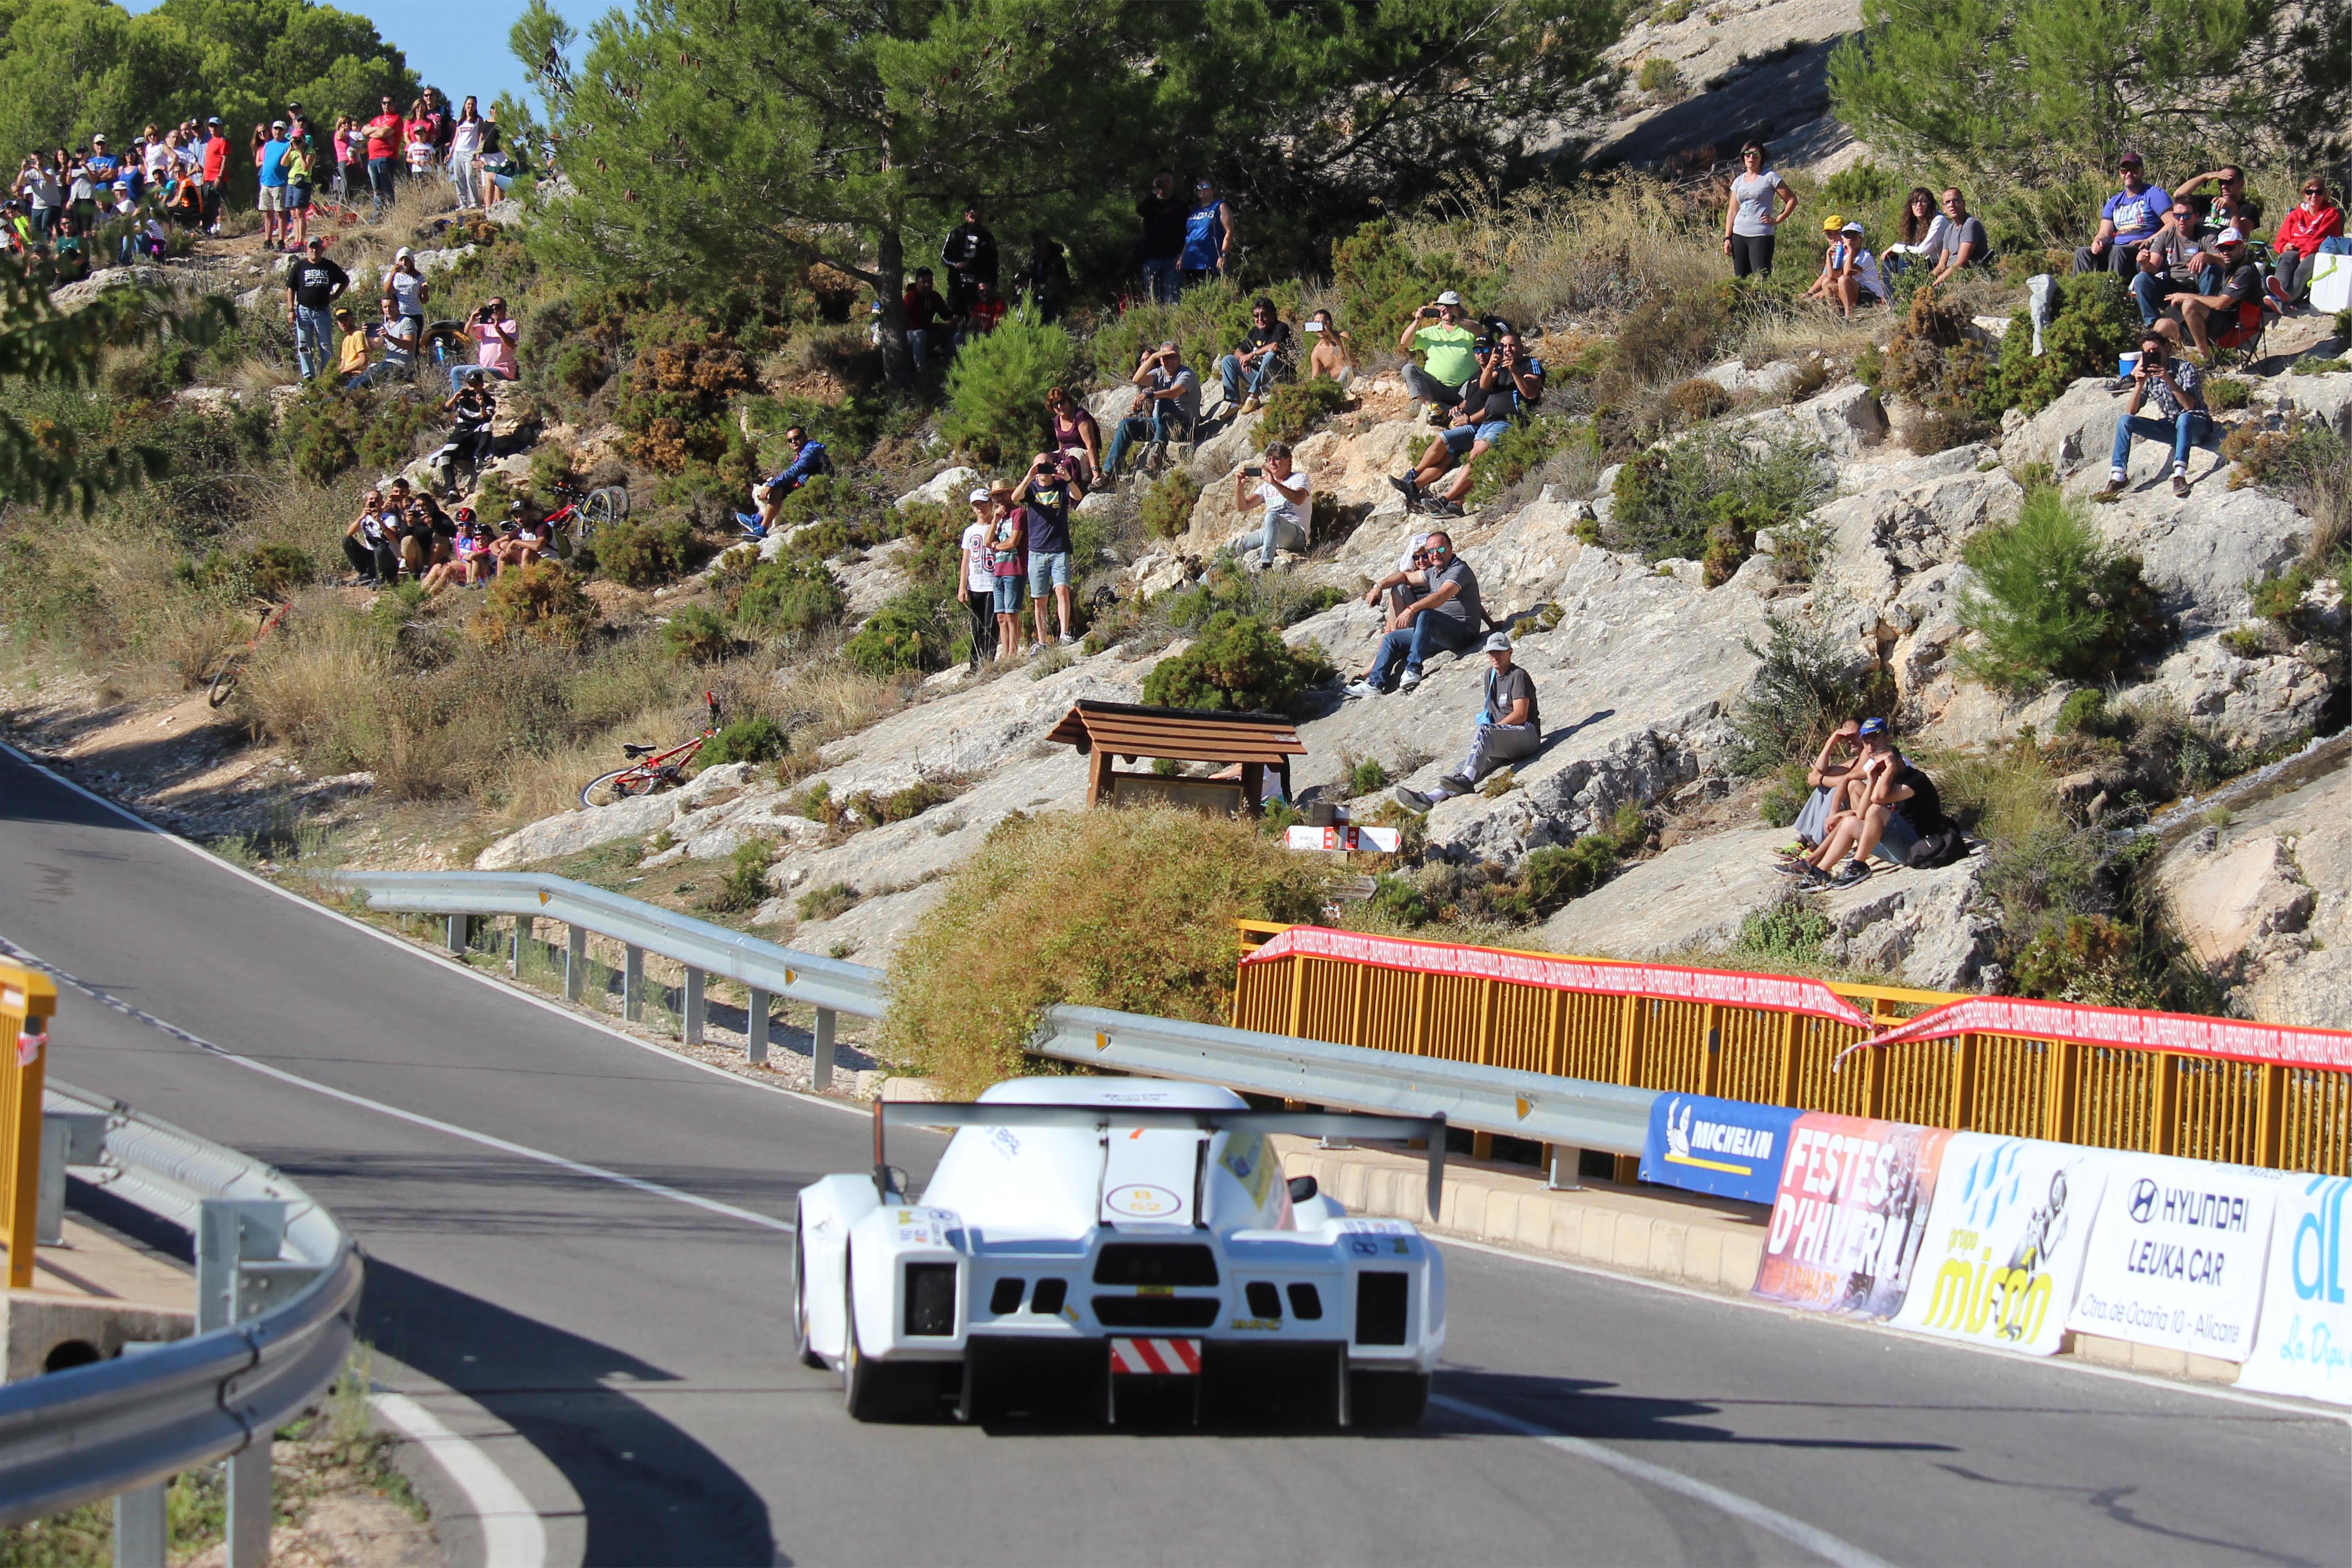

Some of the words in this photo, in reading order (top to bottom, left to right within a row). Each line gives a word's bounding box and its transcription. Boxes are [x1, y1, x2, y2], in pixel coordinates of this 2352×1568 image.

[1690, 1120, 1774, 1160] MICHELIN
[1783, 1128, 1892, 1208] FESTES
[2162, 1188, 2250, 1233] HYUNDAI
[1768, 1193, 1909, 1280] D'HIVERN
[1947, 1228, 1979, 1255] grupo
[2127, 1238, 2184, 1281] LEUKA
[2189, 1246, 2225, 1287] CAR
[2081, 1293, 2107, 1320] Ctra.
[2109, 1298, 2126, 1323] de
[2126, 1301, 2168, 1331] Ocaña
[2171, 1309, 2185, 1334] 10
[2194, 1314, 2240, 1344] Alicante
